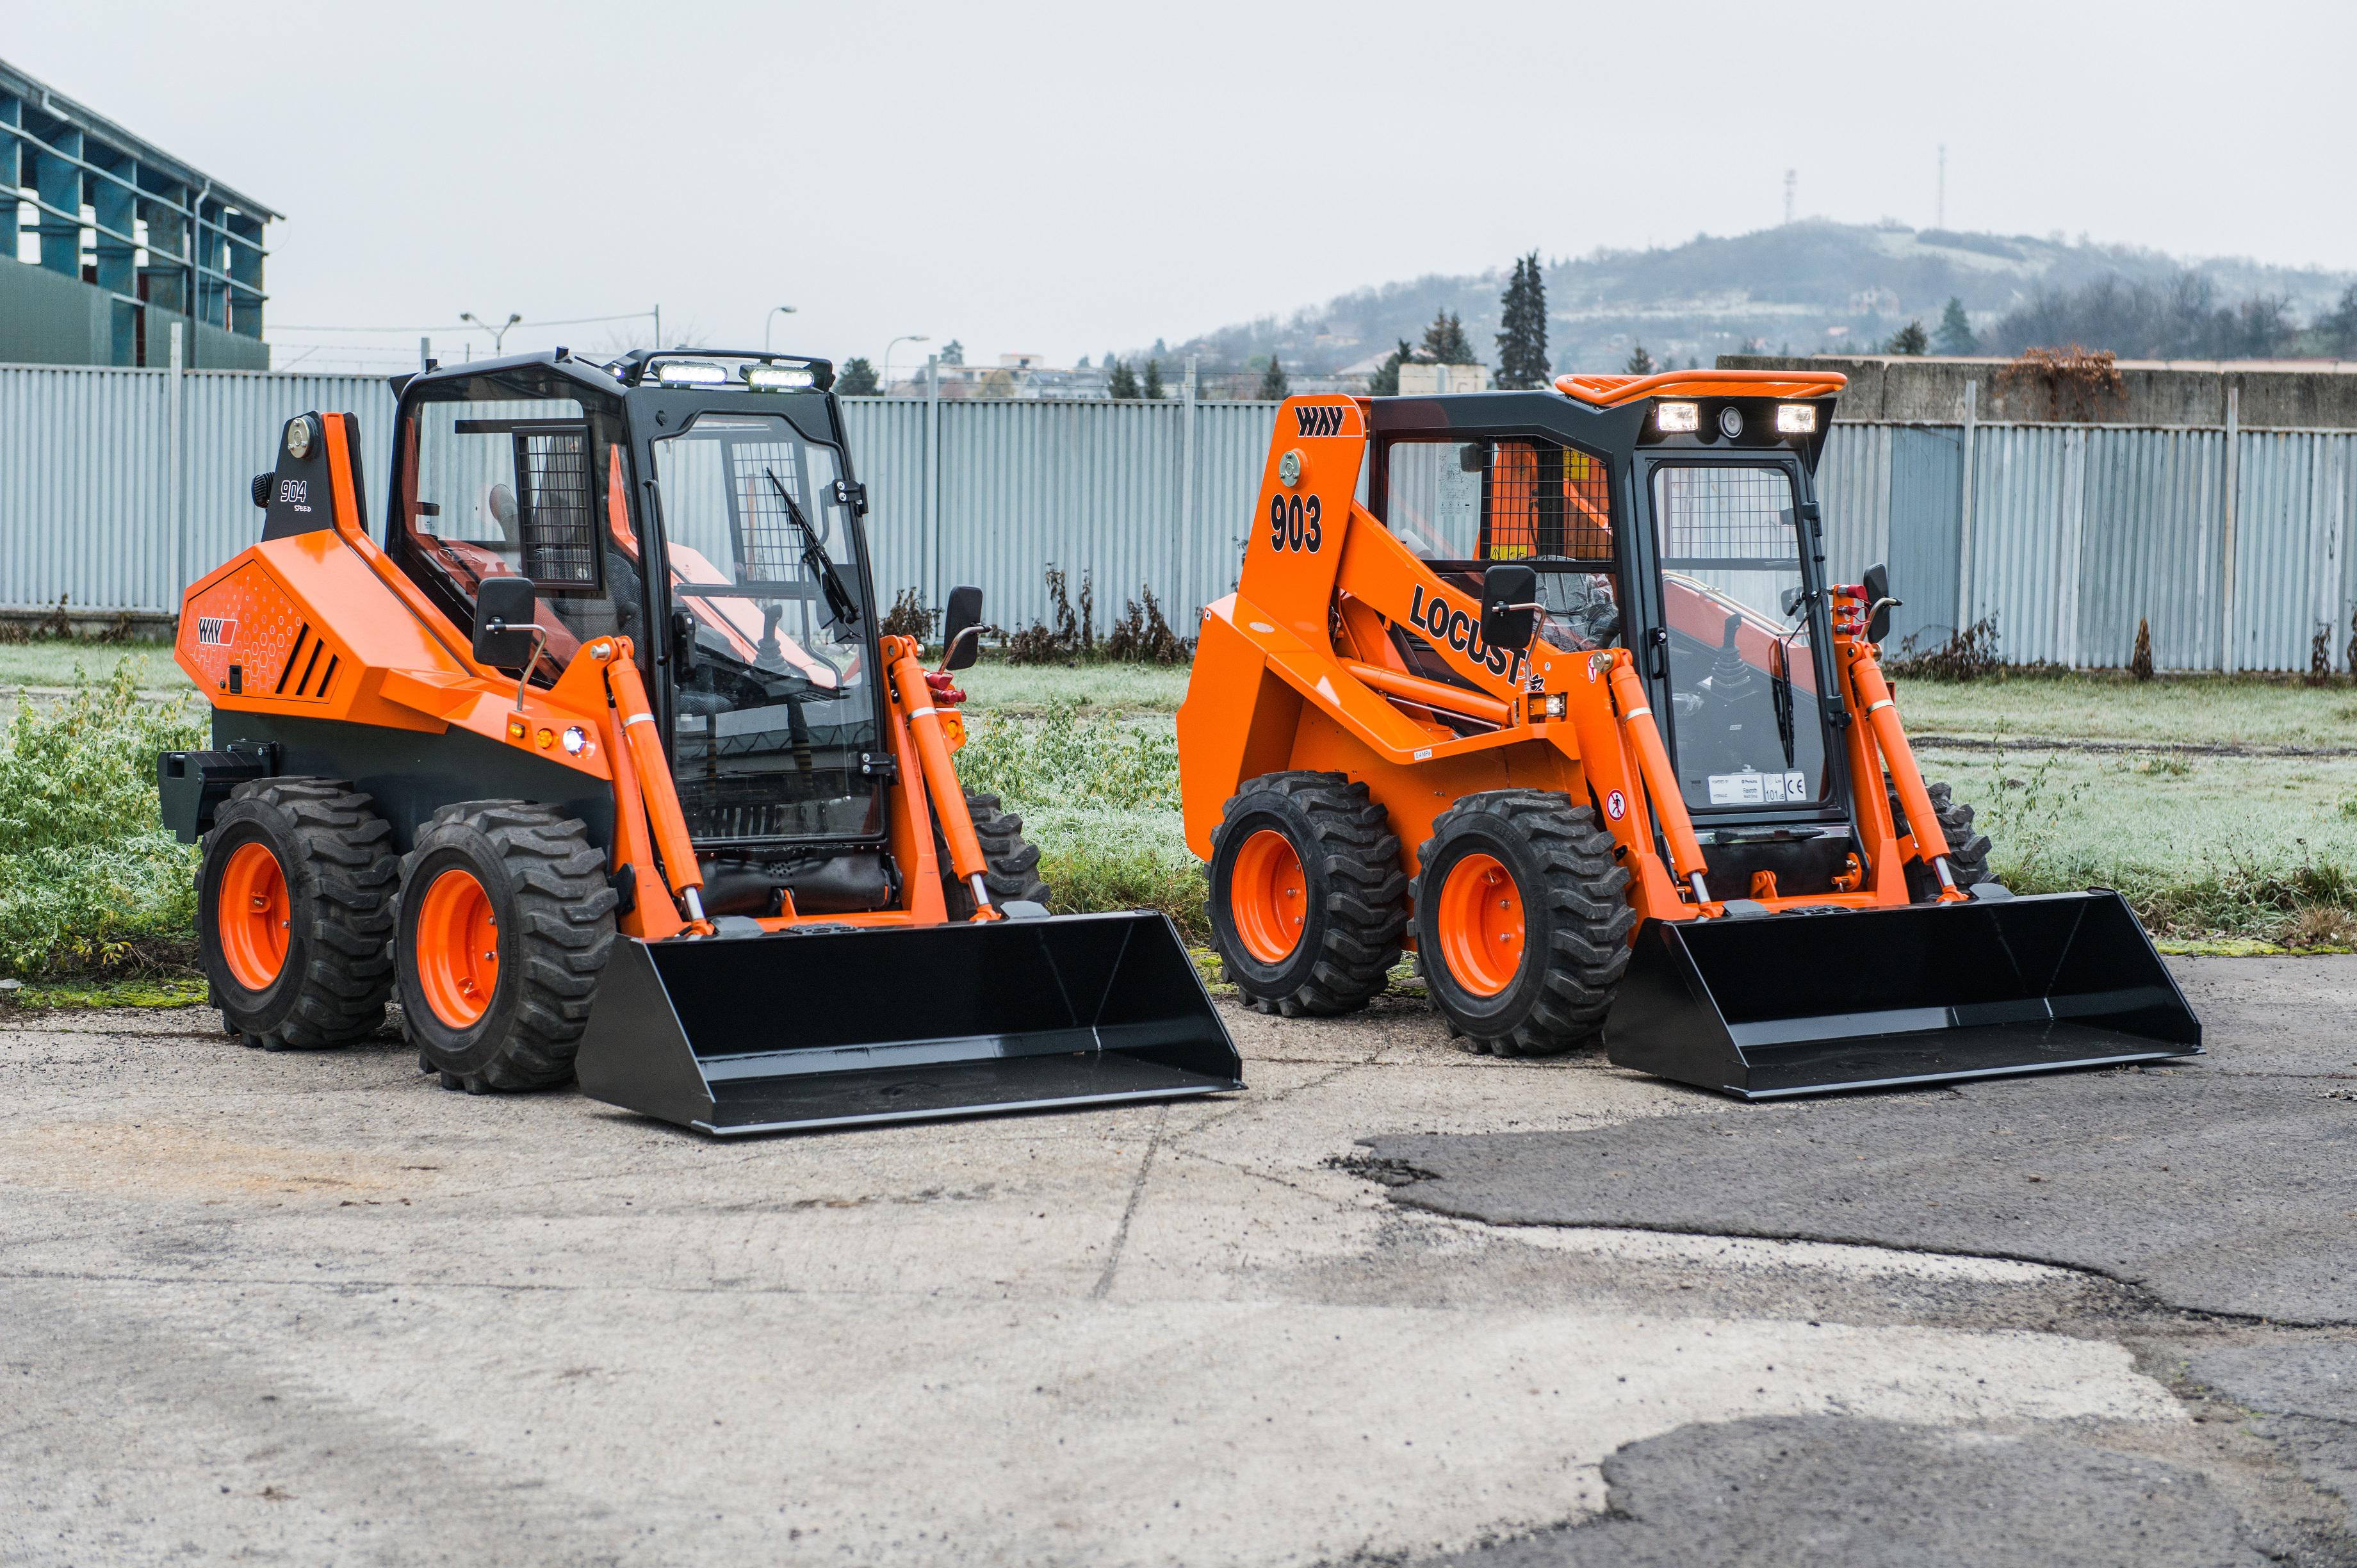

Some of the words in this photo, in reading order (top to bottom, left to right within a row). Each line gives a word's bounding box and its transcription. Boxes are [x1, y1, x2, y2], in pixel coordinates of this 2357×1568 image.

[1294, 405, 1346, 437] WAY
[281, 480, 307, 502] 904
[1270, 493, 1322, 553] 903
[198, 617, 223, 644] WAY
[1765, 790, 1779, 800] 101
